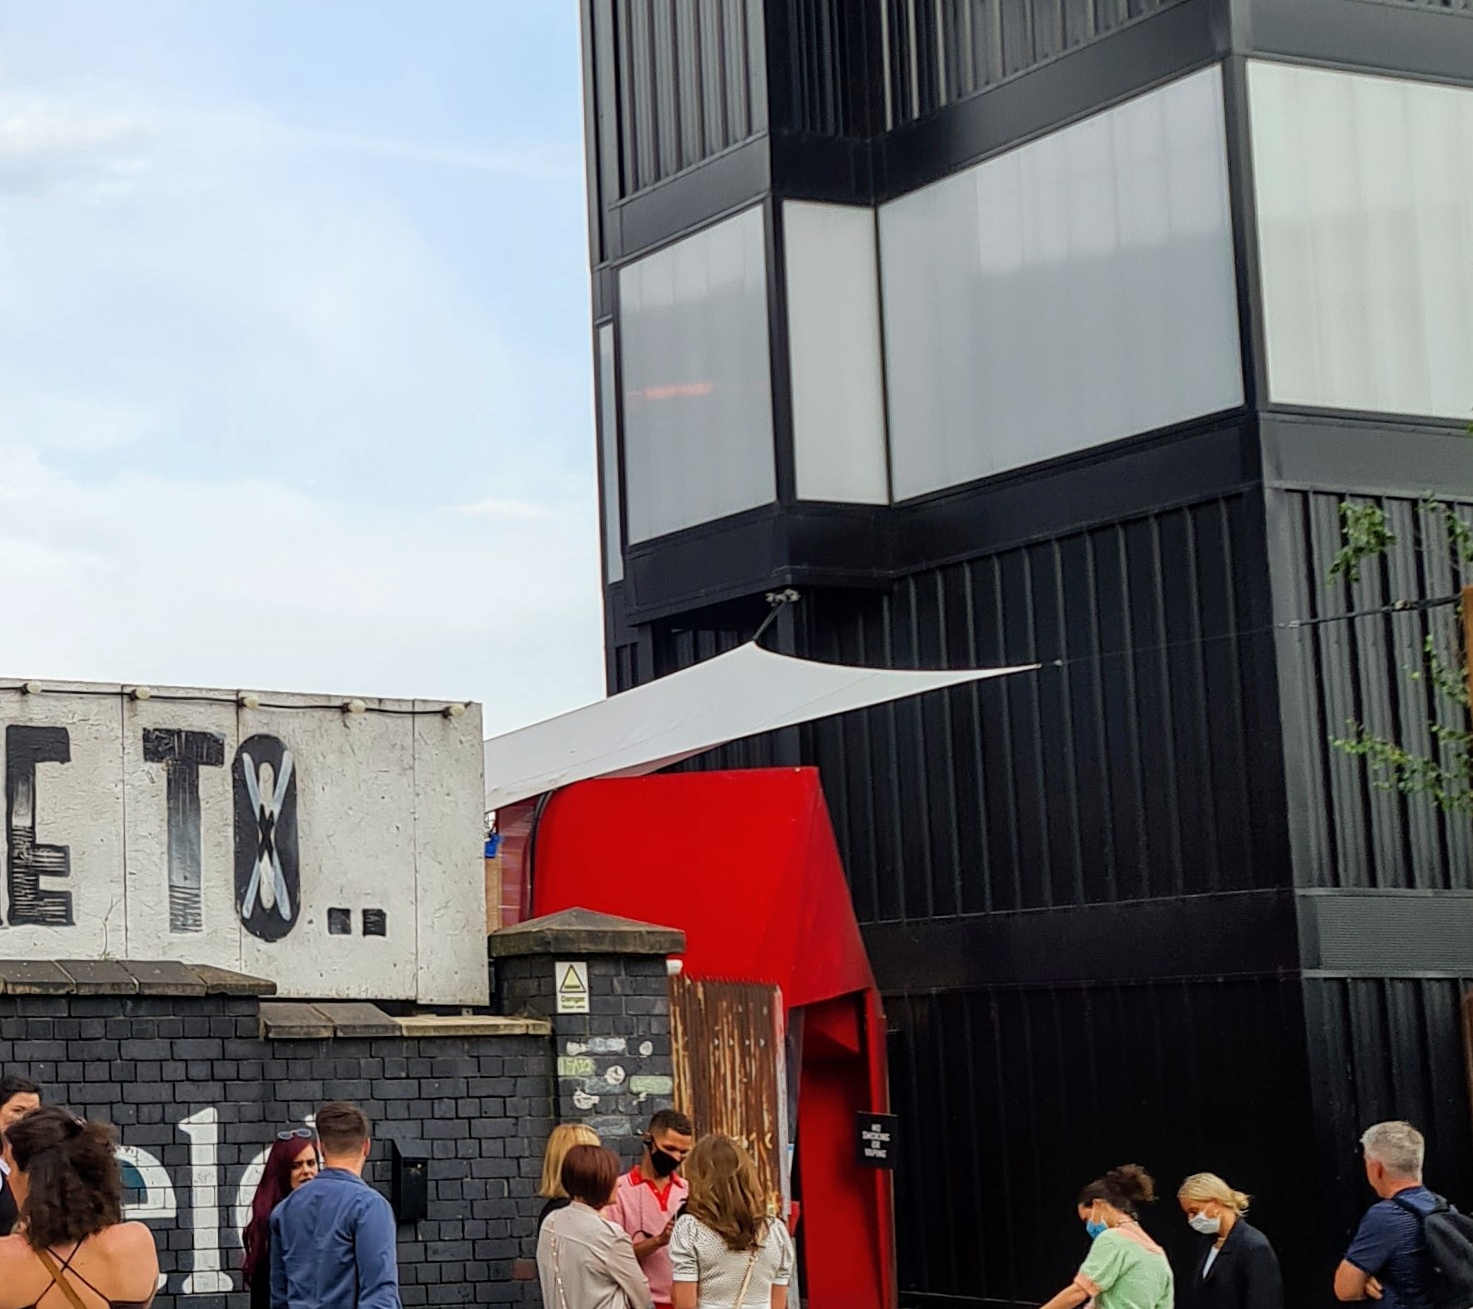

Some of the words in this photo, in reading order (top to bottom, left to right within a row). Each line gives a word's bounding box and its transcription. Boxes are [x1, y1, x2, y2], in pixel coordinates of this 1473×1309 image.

[871, 1123, 881, 1132] NO
[862, 1130, 890, 1141] SMOKING
[864, 1147, 887, 1158] VAPING
